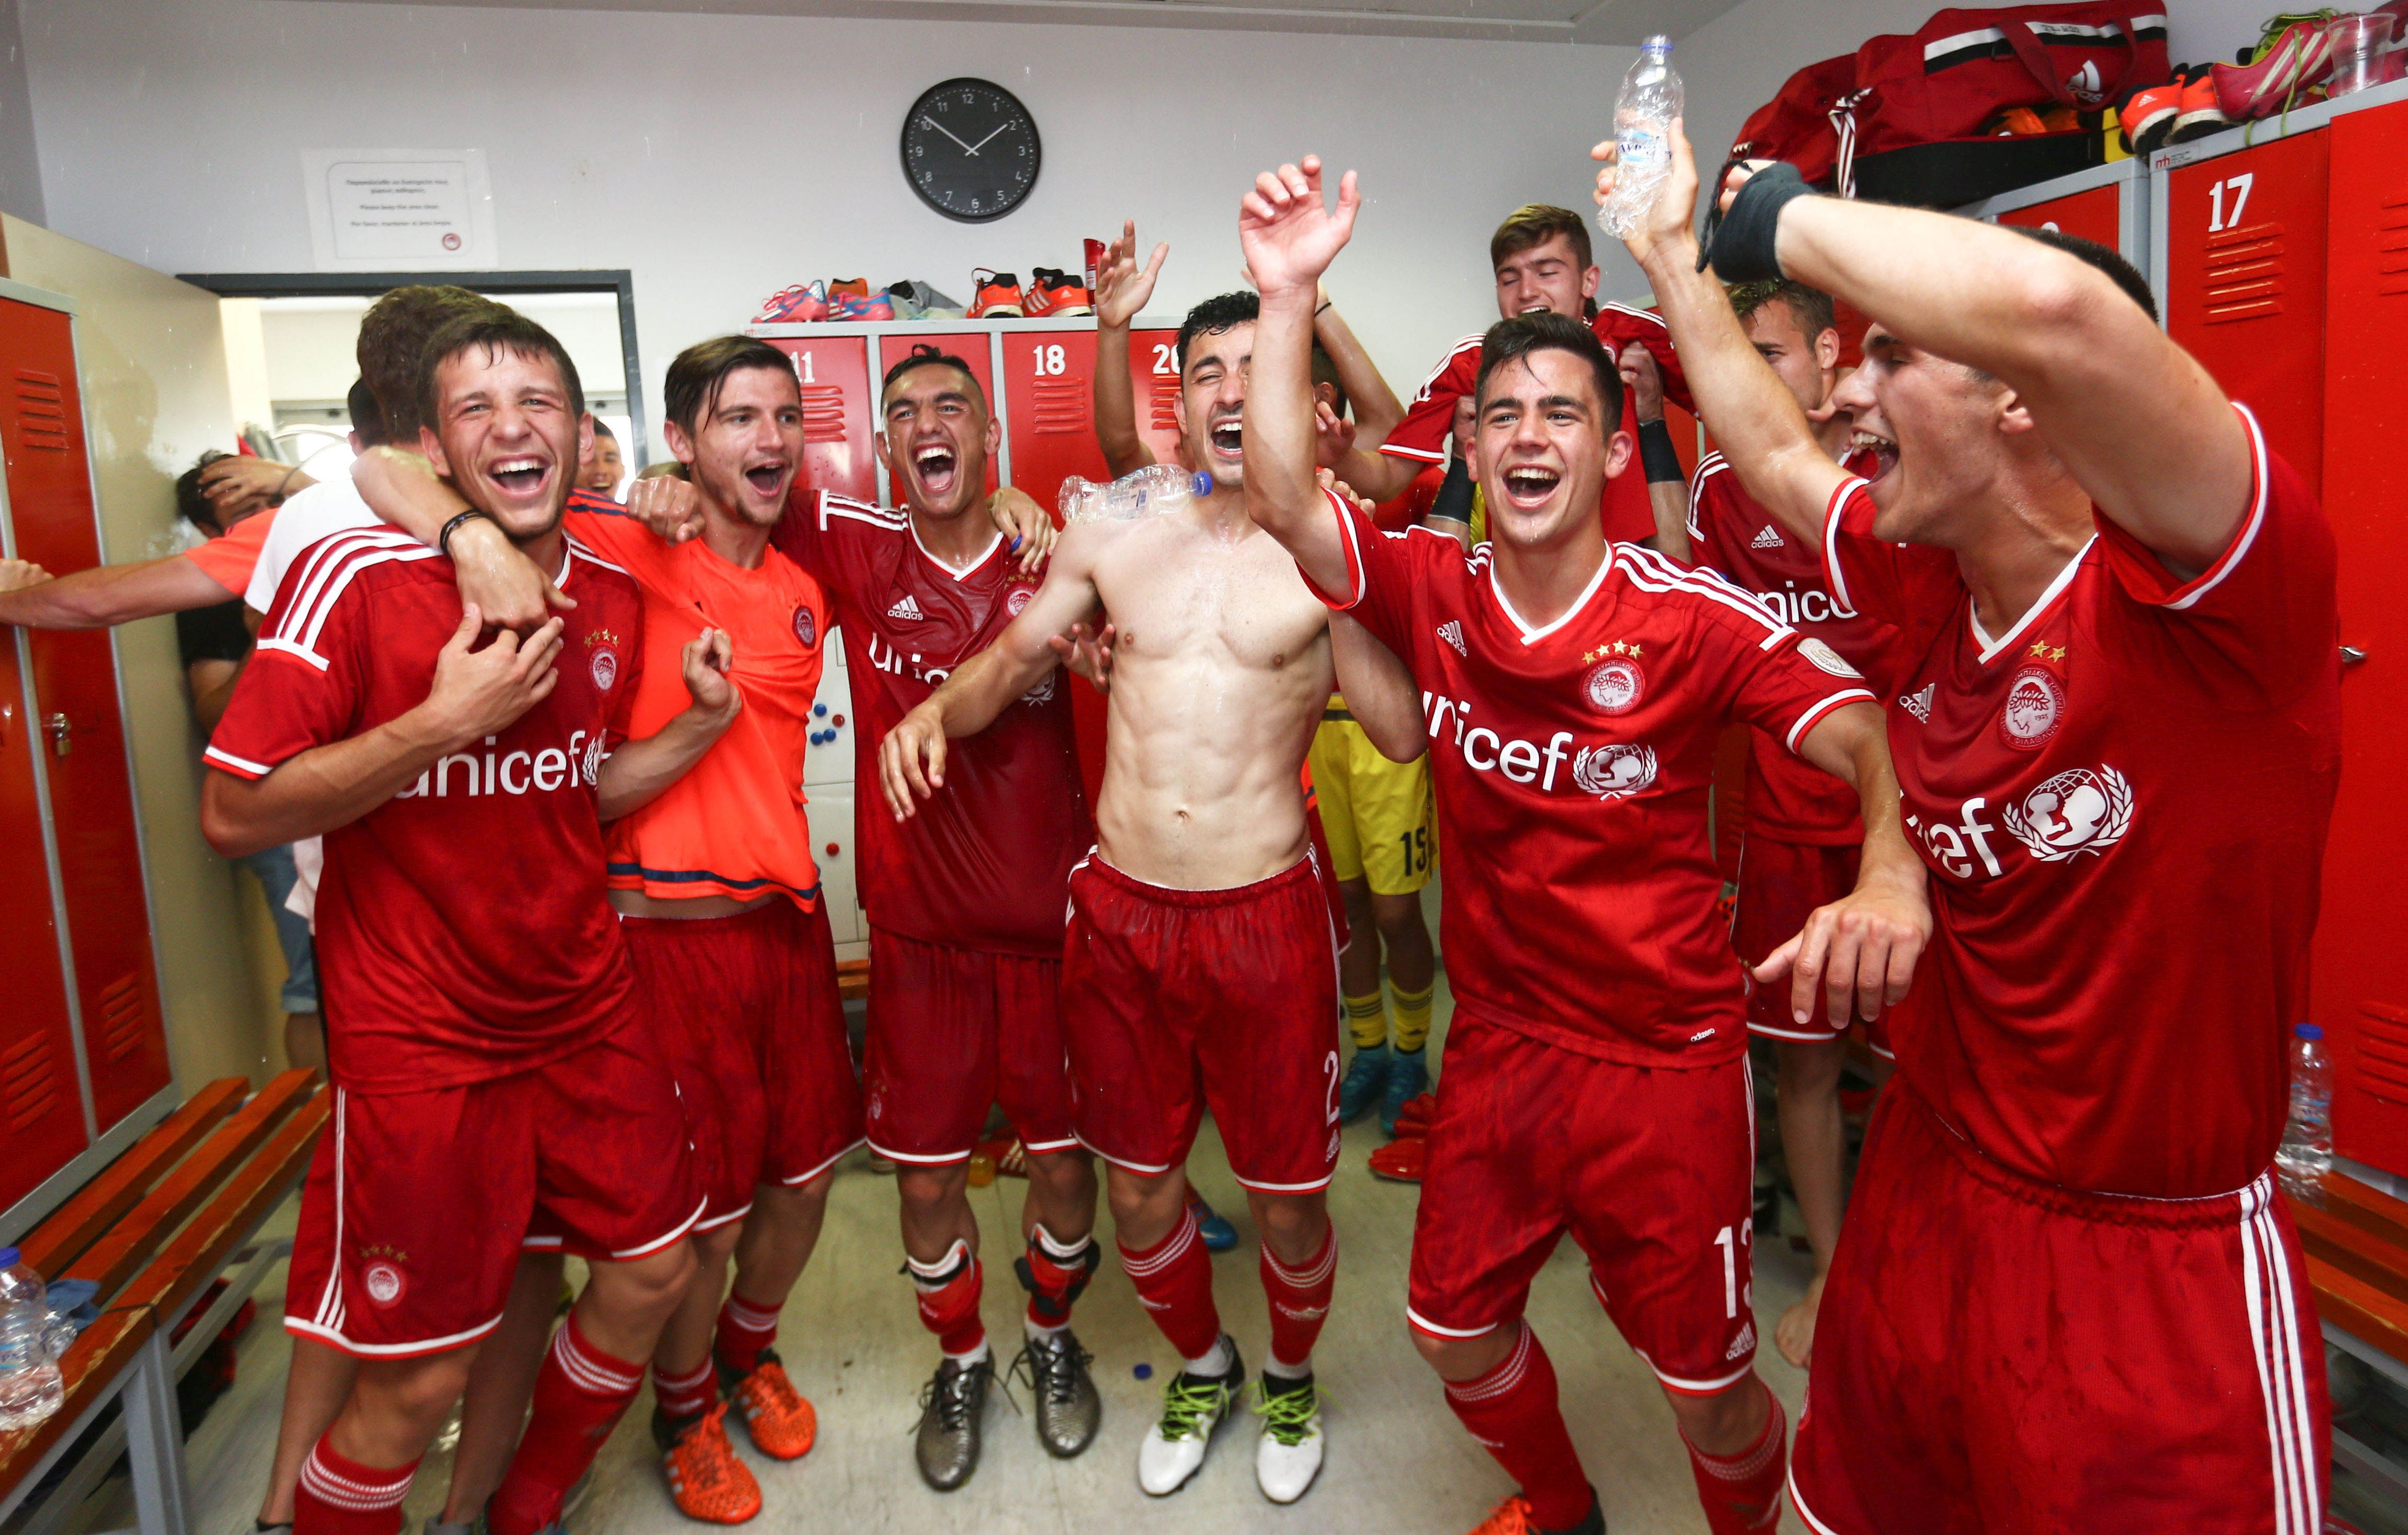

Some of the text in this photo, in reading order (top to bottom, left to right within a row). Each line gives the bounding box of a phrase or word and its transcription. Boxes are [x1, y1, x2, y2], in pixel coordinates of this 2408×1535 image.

[962, 93, 974, 104] 12
[937, 101, 948, 112] 11
[993, 102, 998, 112] 1
[920, 120, 932, 131] 10
[1009, 120, 1017, 131] 2
[915, 146, 924, 157] 9
[1018, 146, 1026, 157] 3
[925, 171, 933, 183] 8
[1015, 171, 1022, 181] 4
[945, 191, 953, 201] 7
[997, 190, 1005, 201] 5
[971, 199, 980, 209] 6
[2208, 172, 2253, 233] 17
[1033, 344, 1066, 376] 18
[789, 351, 815, 383] 11
[1751, 539, 1784, 549] adidas
[887, 609, 923, 620] adidas
[1437, 627, 1467, 657] adidas
[1691, 1028, 1715, 1042] adizero
